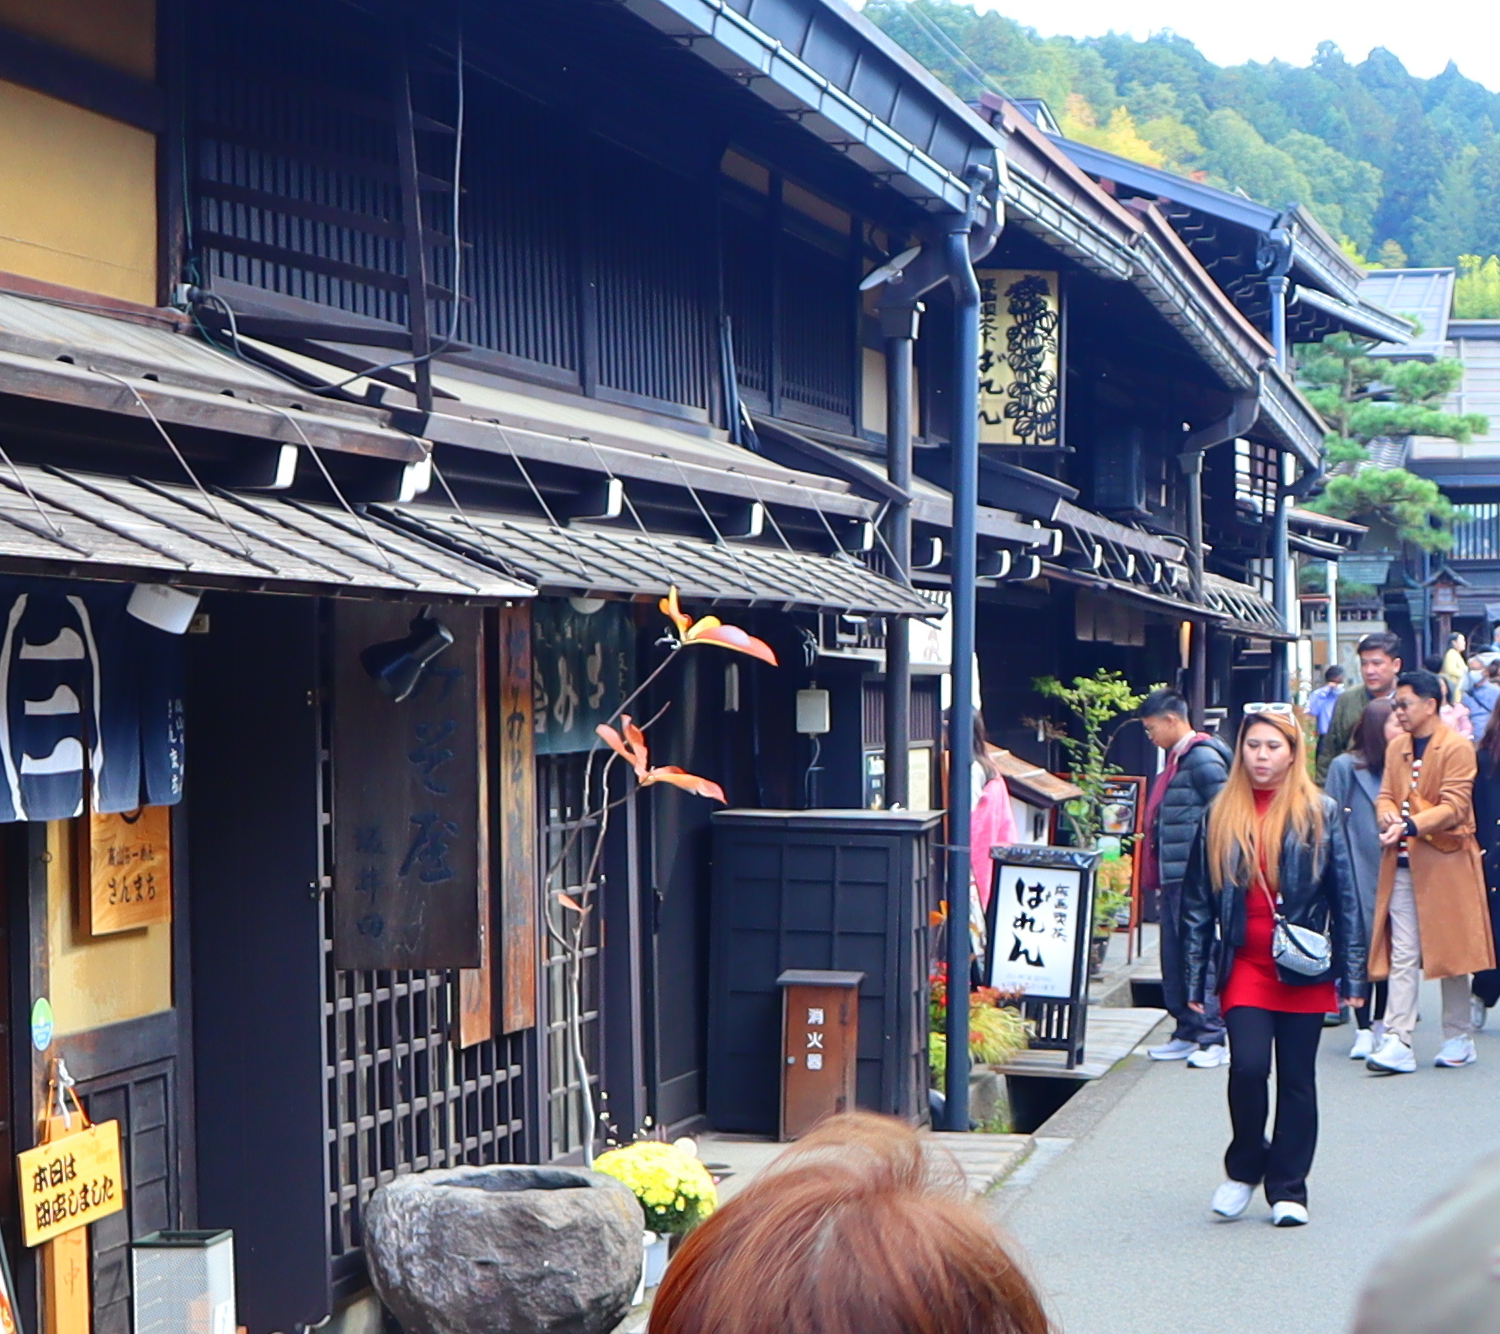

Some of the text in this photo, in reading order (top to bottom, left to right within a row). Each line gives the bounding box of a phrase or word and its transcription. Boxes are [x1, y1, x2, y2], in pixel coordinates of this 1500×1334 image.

[108, 872, 156, 905] さんまち
[1008, 876, 1051, 967] ばれん
[806, 1007, 825, 1070] 消火器
[33, 1153, 77, 1193] 本日は
[35, 1175, 114, 1231] 閉店しました
